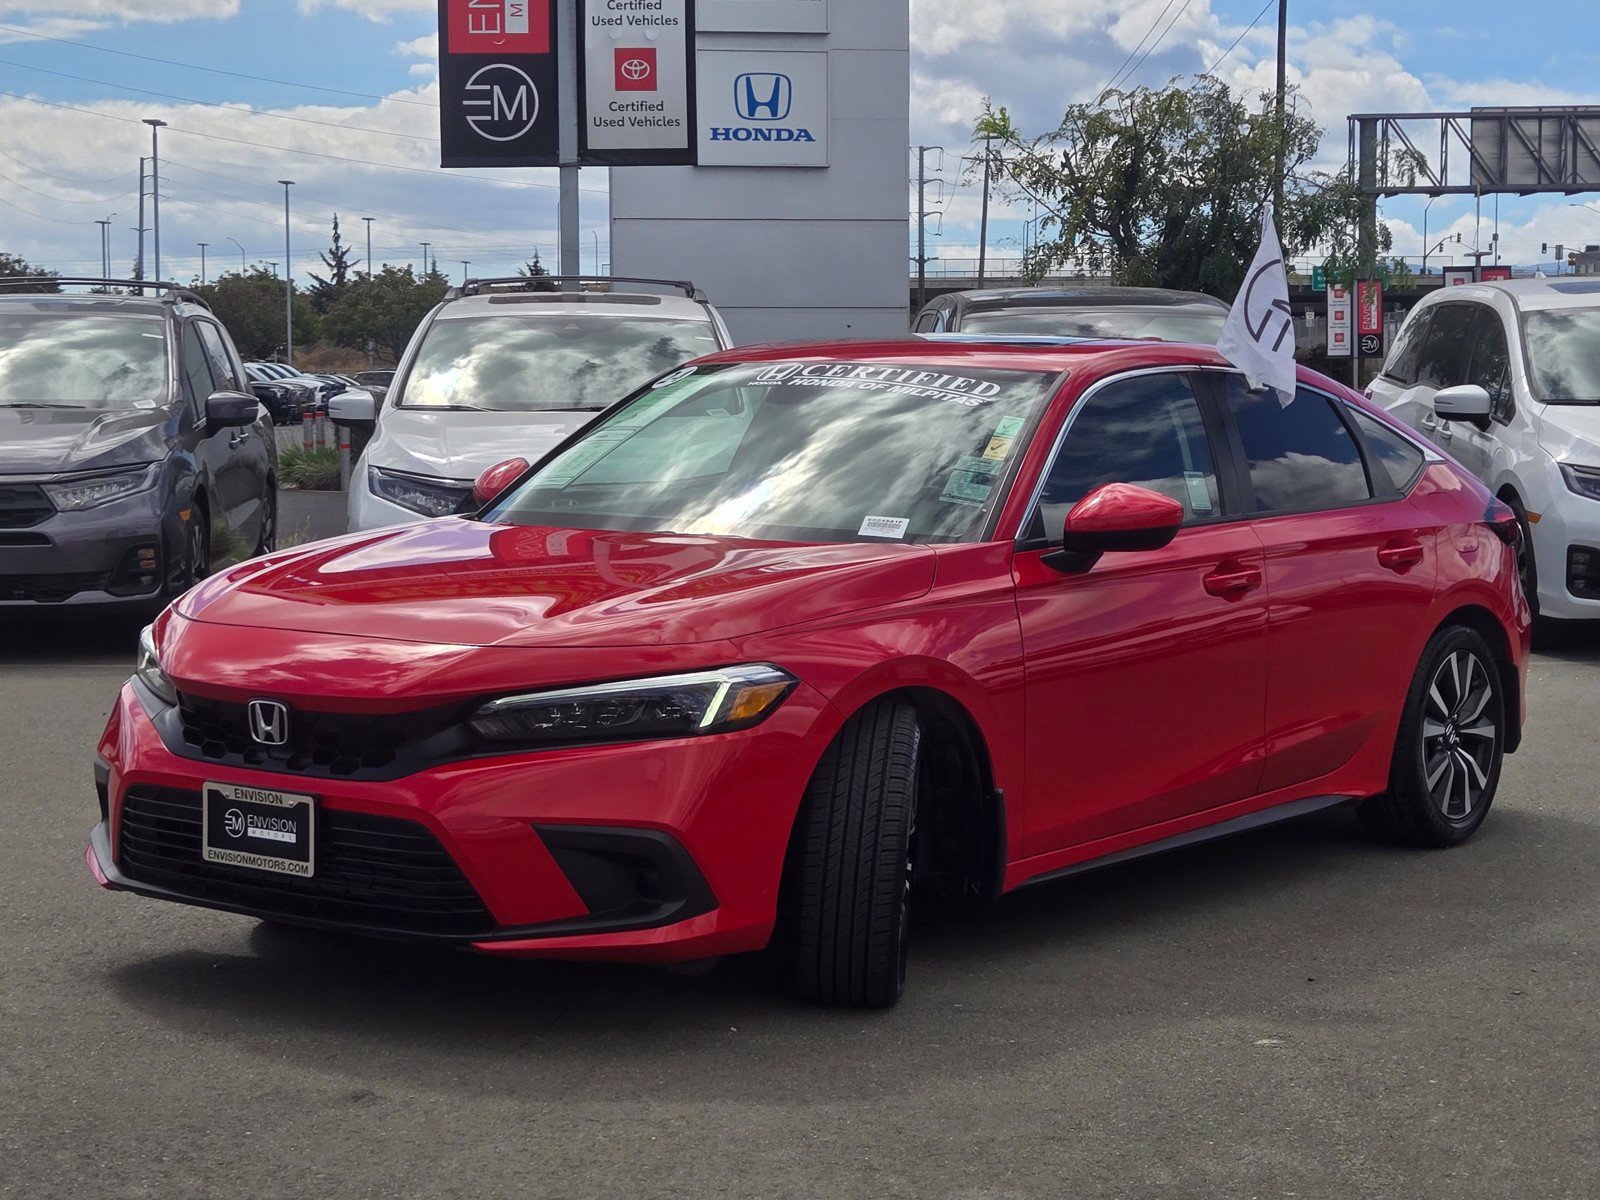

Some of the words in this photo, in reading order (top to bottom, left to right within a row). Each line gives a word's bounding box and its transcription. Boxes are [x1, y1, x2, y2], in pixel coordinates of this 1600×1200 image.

[607, 0, 662, 10] Certified
[592, 15, 623, 27] Used
[628, 15, 679, 27] Vehicles
[609, 101, 664, 113] Certified
[593, 117, 625, 128] Used
[628, 116, 681, 128] Vehicles
[710, 127, 816, 142] HONDA
[801, 364, 1001, 396] CERTIFIED
[787, 379, 855, 389] HONDA
[858, 383, 890, 391] OF
[886, 385, 984, 407] MILPITAS
[234, 788, 283, 805] ENVISION
[247, 814, 297, 834] ENVISION
[208, 849, 309, 875] ENVISIONMOTORS.COM
